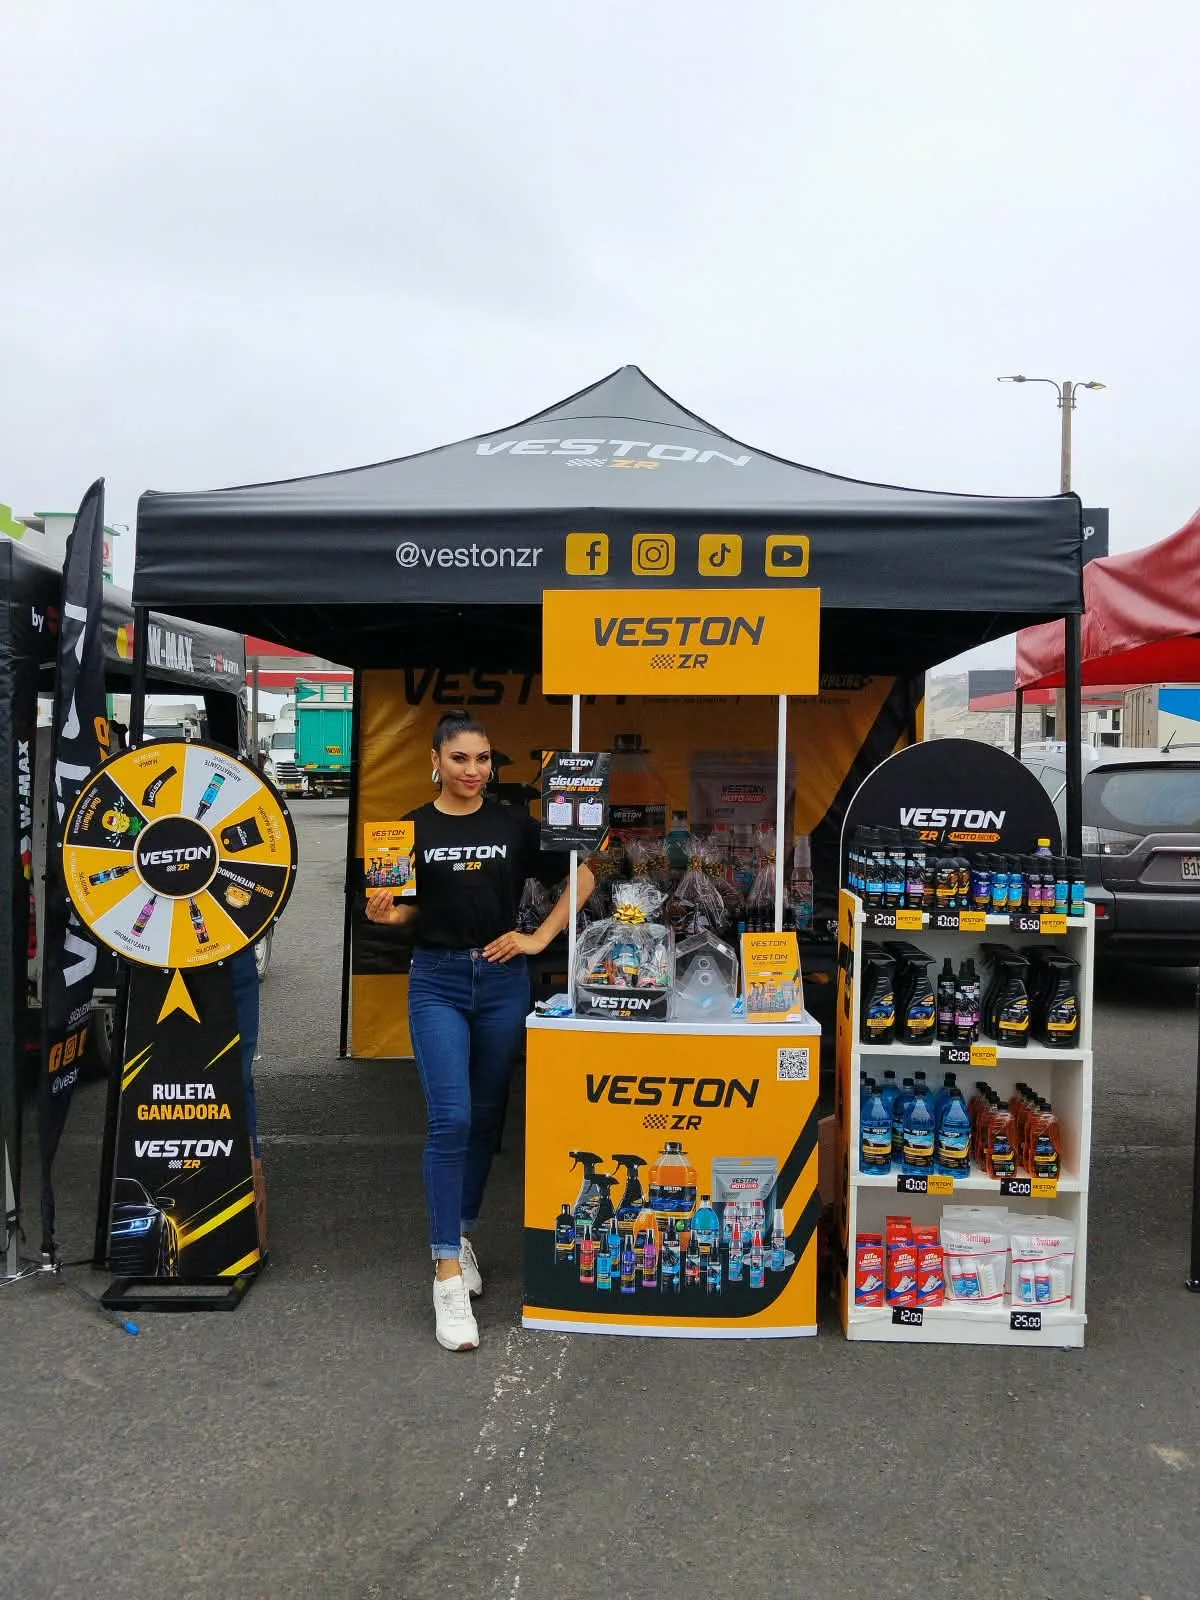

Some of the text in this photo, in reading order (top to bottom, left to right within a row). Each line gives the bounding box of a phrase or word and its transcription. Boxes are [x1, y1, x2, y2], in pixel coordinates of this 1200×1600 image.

[475, 438, 752, 468] VESTON
[608, 459, 661, 470] ZR
[395, 542, 543, 569] @vestonzr
[32, 606, 44, 633] by
[593, 615, 765, 647] VESTON
[677, 653, 709, 670] ZR
[18, 740, 31, 828] W-MAX
[548, 776, 603, 786] SÍGUENOS
[899, 808, 1006, 829] VESTON
[919, 830, 938, 840] ZR
[140, 845, 212, 866] VESTON
[424, 844, 507, 864] VESTON
[177, 863, 190, 871] ZR
[466, 861, 482, 870] ZR
[254, 884, 275, 898] SIGUE
[1020, 918, 1040, 930] 6.50
[111, 928, 151, 952] AROMATIZANTE
[591, 996, 651, 1010] VESTON
[948, 1049, 970, 1061] 12.00
[153, 1083, 216, 1100] RULETA
[585, 1074, 760, 1109] VESTON
[137, 1103, 231, 1120] GANADORA
[669, 1114, 703, 1131] ZR
[134, 1139, 234, 1158] VESTON
[183, 1159, 201, 1169] ZR
[1014, 1314, 1041, 1328] 25.00
